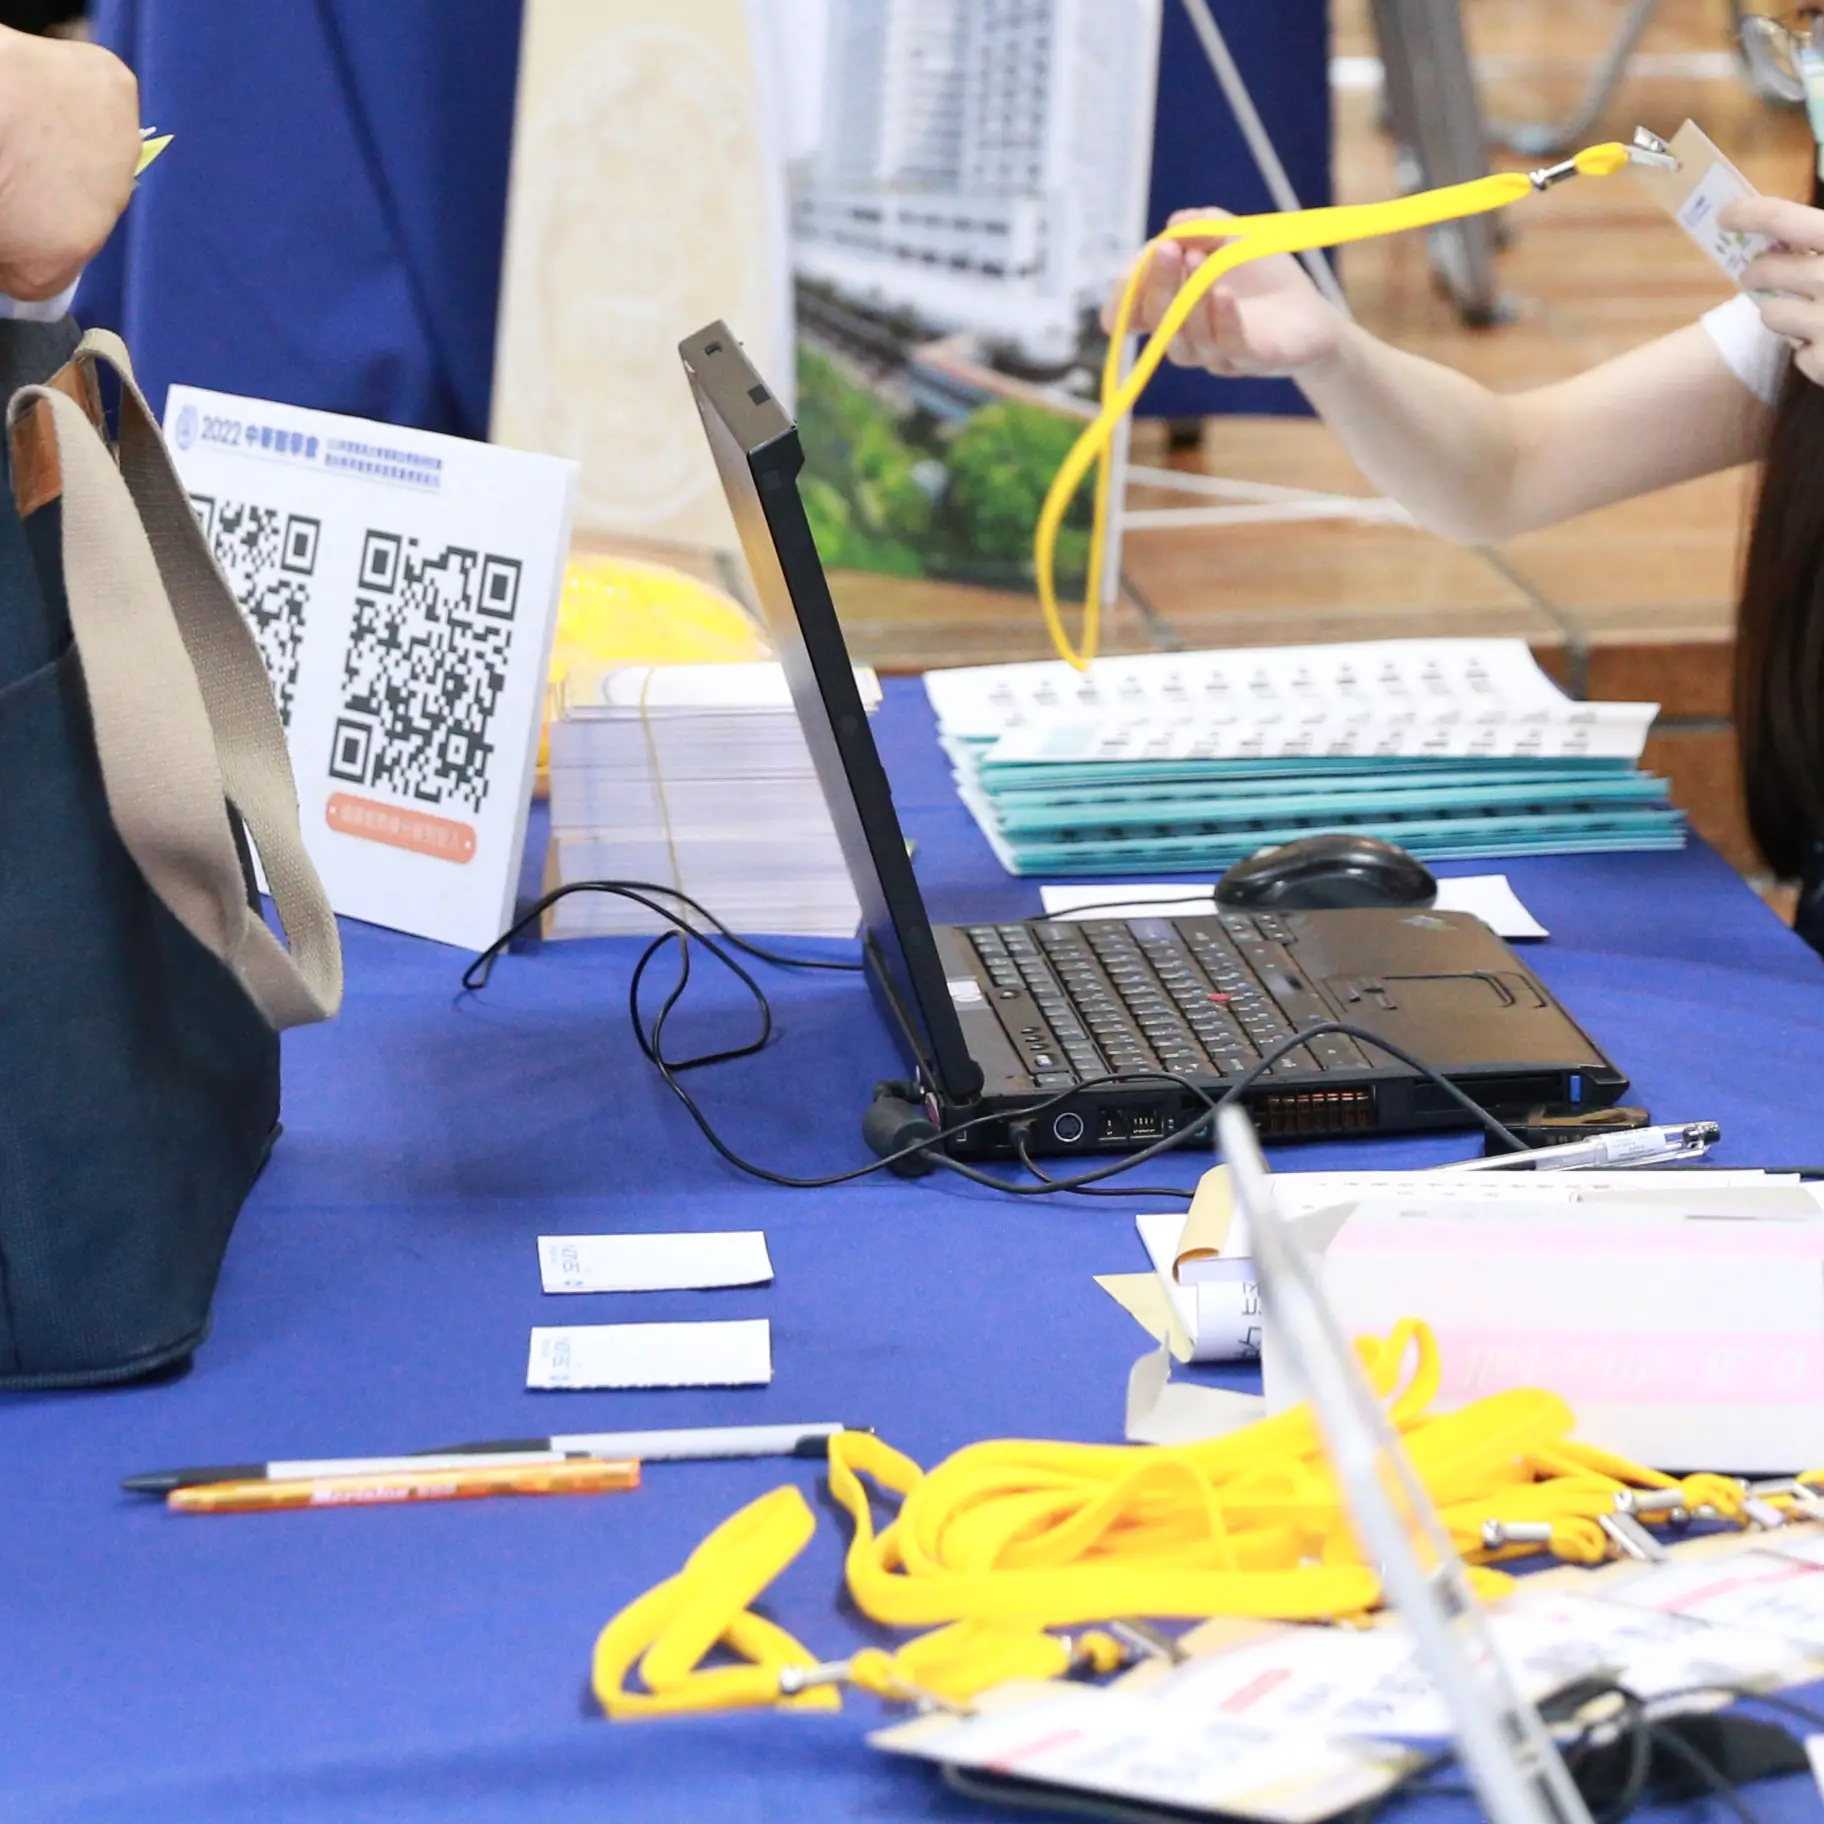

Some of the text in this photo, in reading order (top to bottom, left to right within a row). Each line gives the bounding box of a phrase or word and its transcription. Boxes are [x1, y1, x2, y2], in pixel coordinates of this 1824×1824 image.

[201, 416, 242, 447] 2022
[245, 423, 320, 459] 中華醫學會
